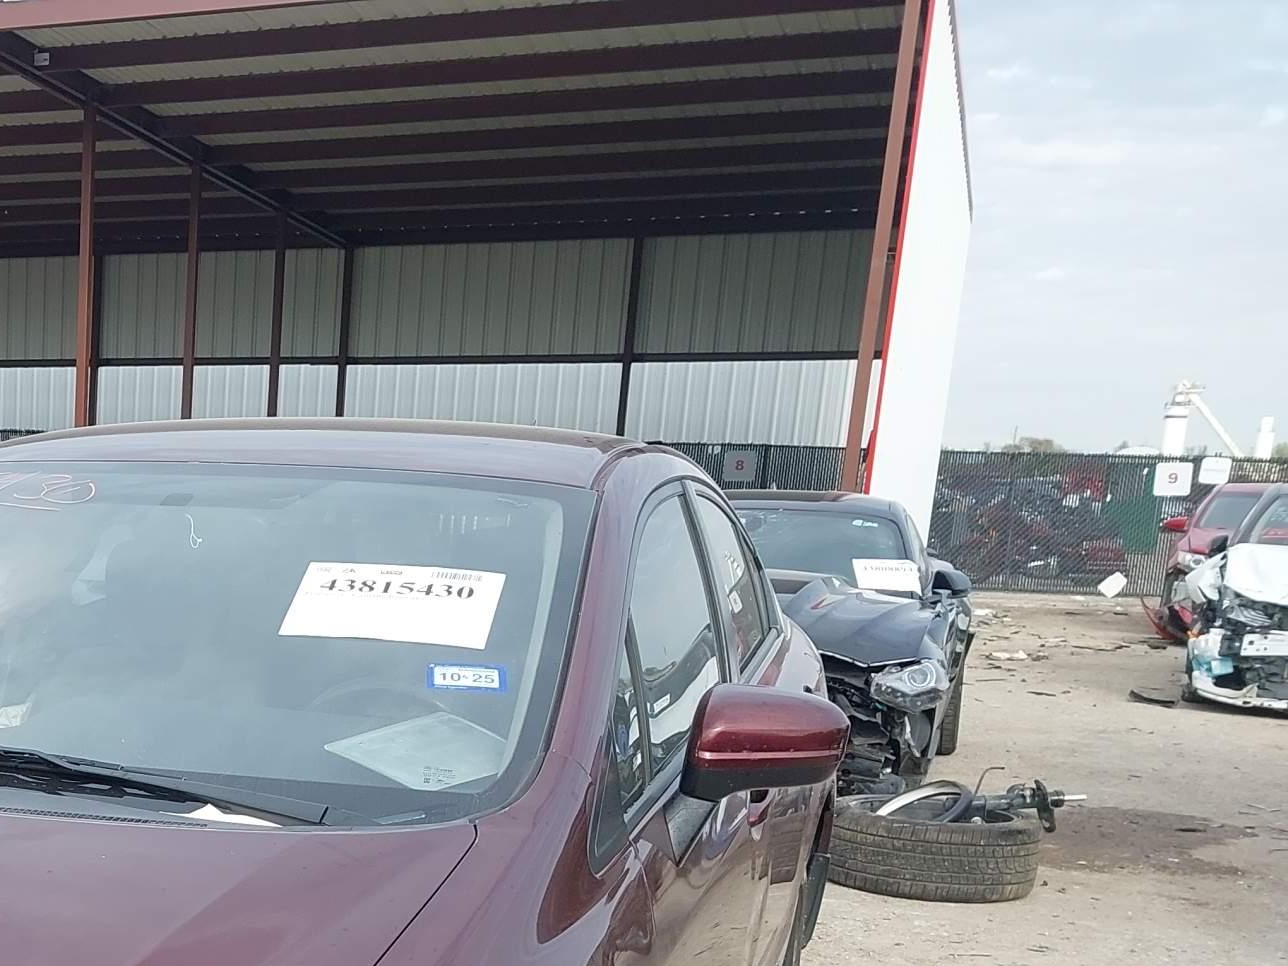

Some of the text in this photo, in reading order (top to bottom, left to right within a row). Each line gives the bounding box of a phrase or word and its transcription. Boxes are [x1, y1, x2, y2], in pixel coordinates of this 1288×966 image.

[734, 459, 745, 471] 8
[1168, 472, 1178, 484] 9
[319, 578, 475, 599] 43815430
